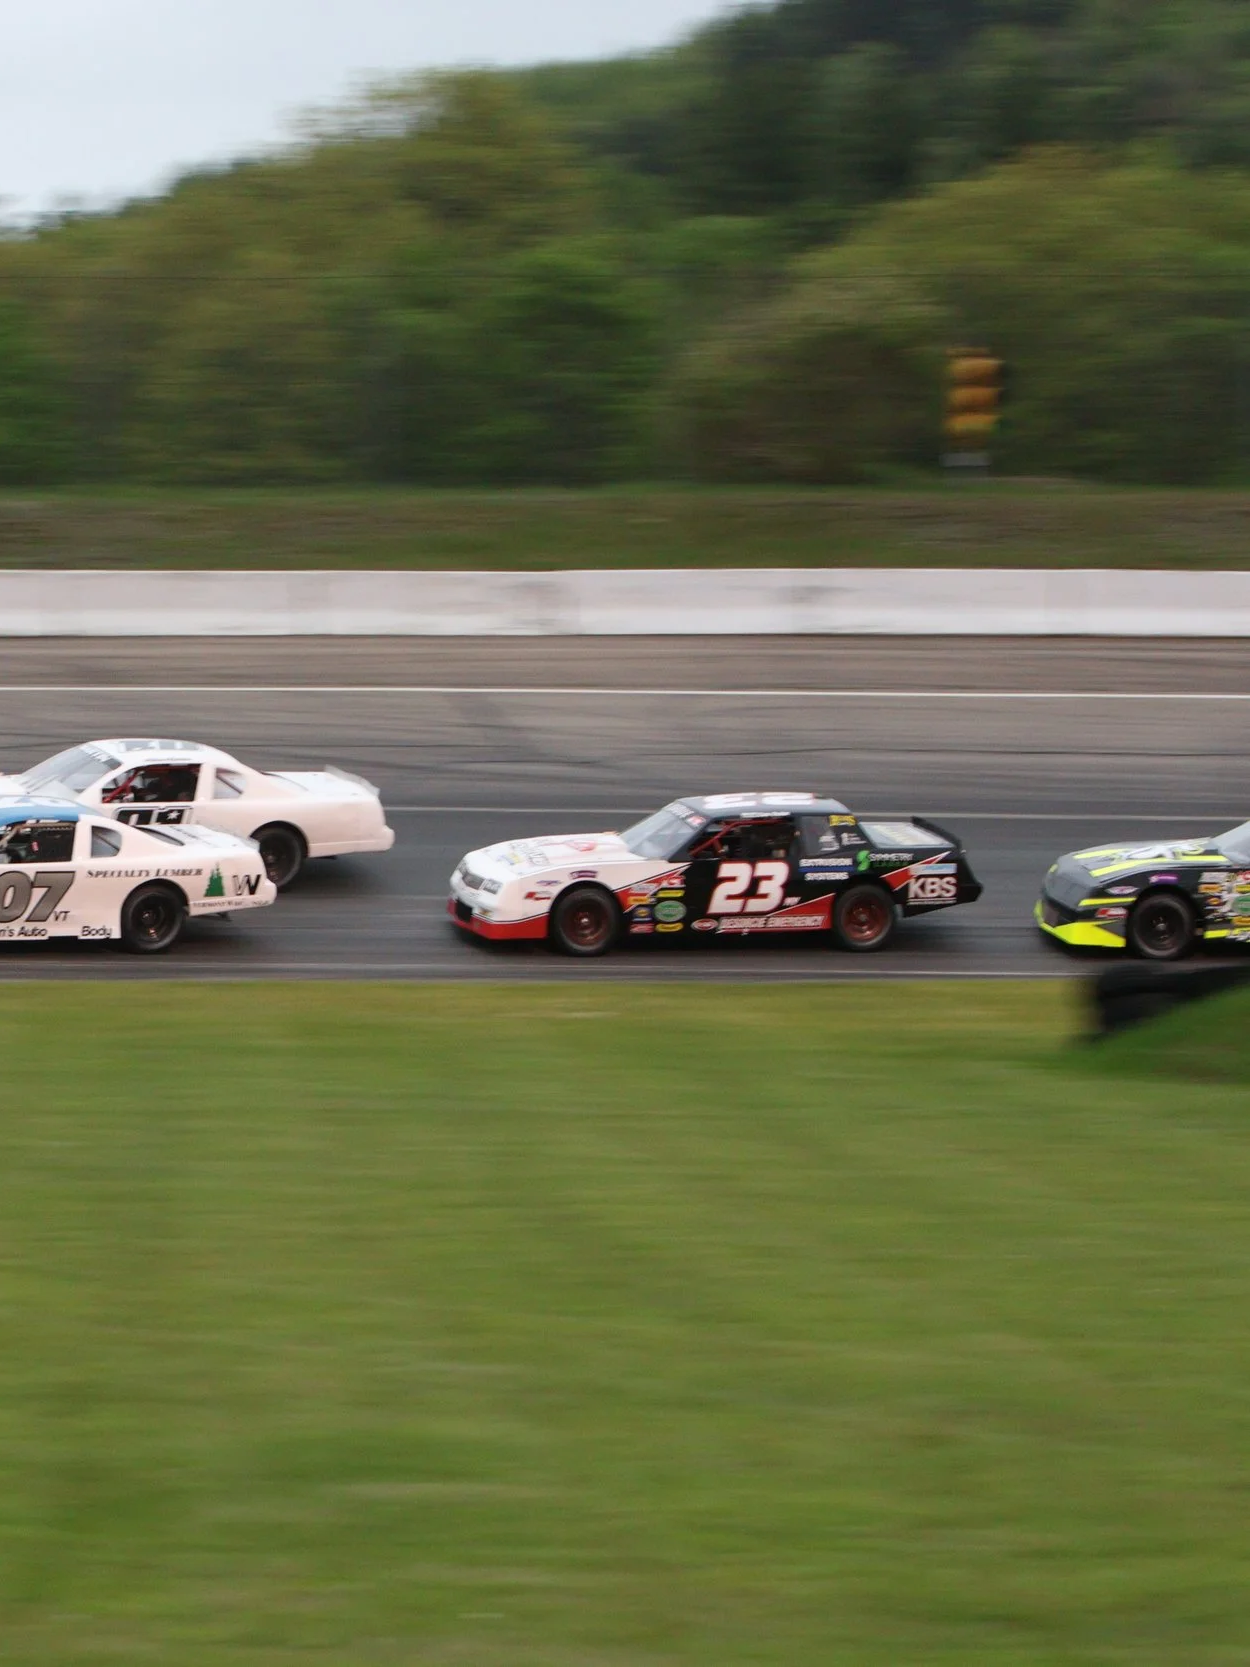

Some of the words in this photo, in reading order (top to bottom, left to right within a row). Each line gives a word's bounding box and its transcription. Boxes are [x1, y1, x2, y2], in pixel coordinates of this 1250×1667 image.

[87, 870, 150, 879] SPECIALTY
[154, 868, 204, 877] LUMBER
[805, 871, 850, 881] SYSTEMS
[706, 860, 790, 912] 23
[907, 877, 958, 898] KBS
[54, 911, 71, 921] VT
[17, 926, 48, 937] Auto
[81, 925, 113, 939] Body
